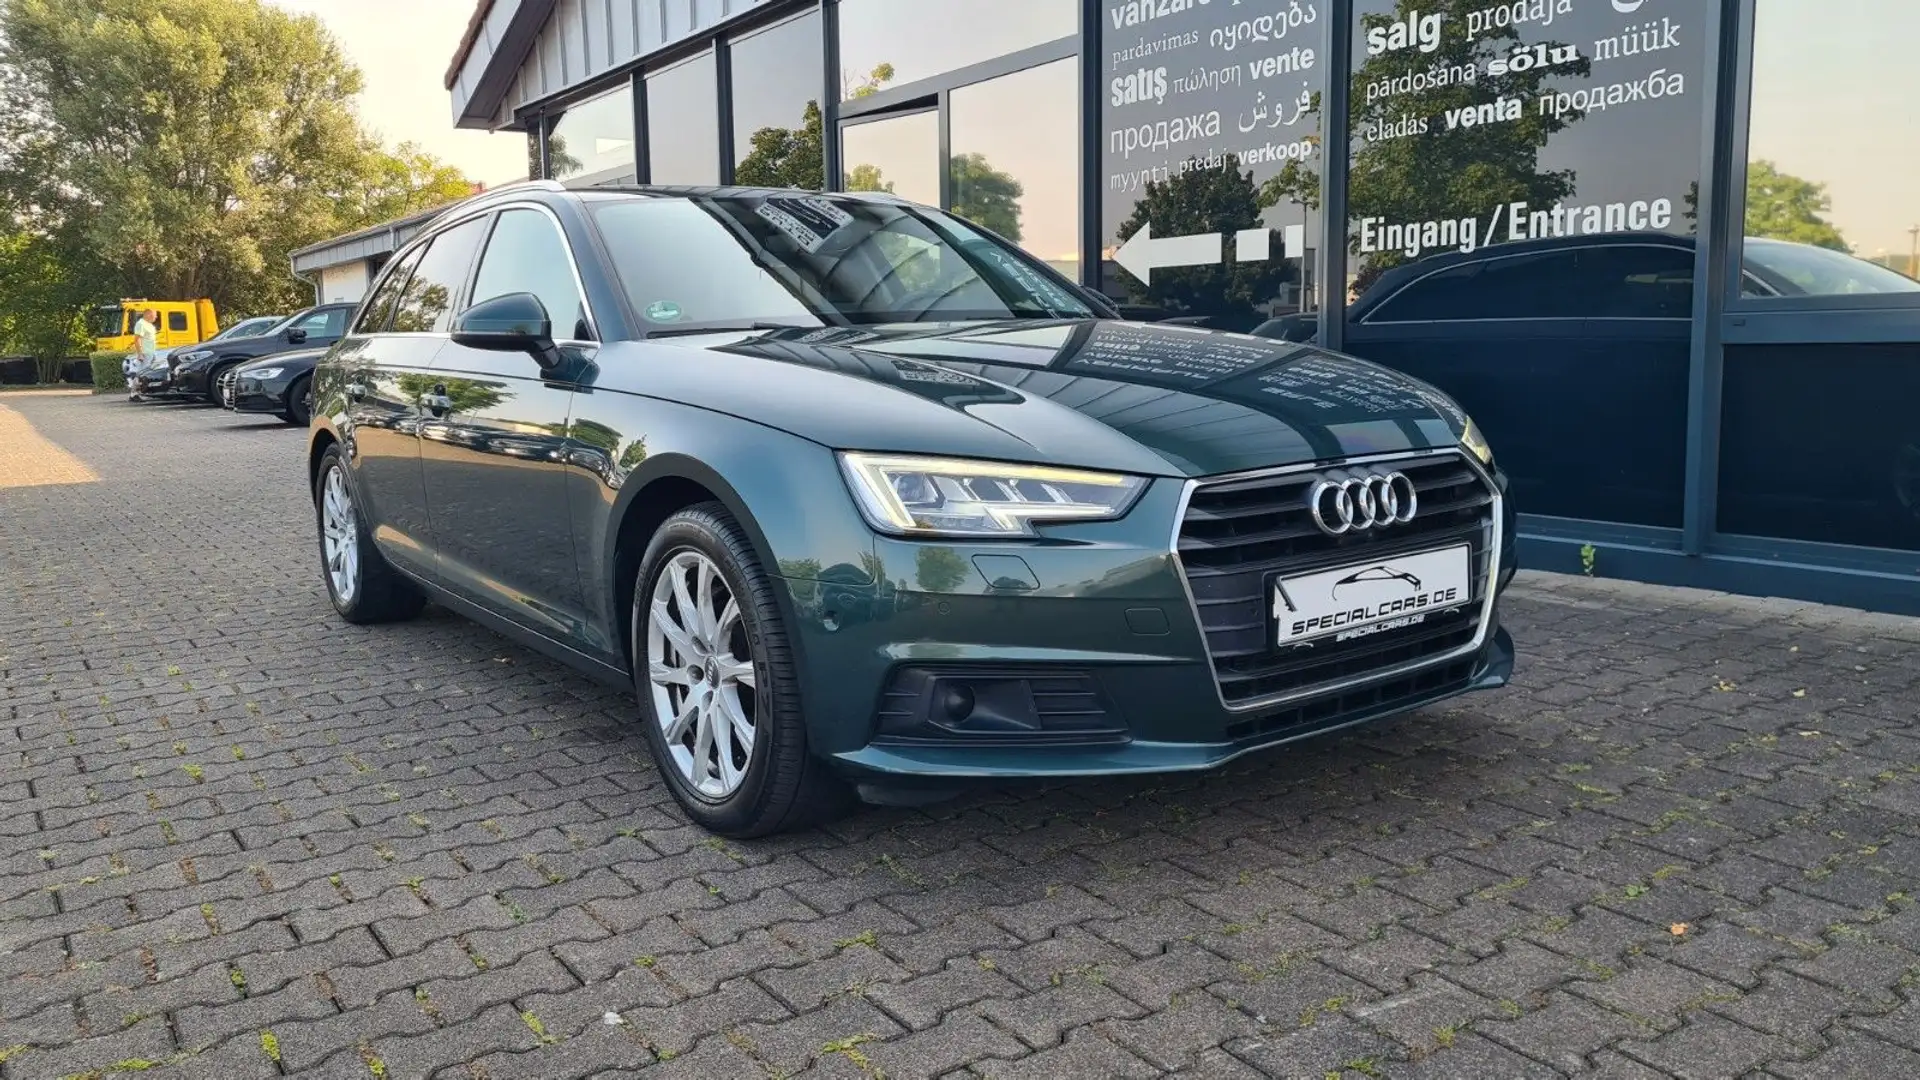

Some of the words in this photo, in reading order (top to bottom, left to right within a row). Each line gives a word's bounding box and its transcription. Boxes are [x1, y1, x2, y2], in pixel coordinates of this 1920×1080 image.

[1112, 30, 1199, 71] pardavimas
[1366, 10, 1442, 55] salg
[1594, 17, 1682, 61] müük
[1173, 65, 1241, 95] πώληση
[1249, 46, 1315, 80] vente
[1487, 43, 1581, 77] sölu
[1366, 63, 1476, 105] pārdošana
[1539, 68, 1685, 120] продажба
[1238, 81, 1311, 132] فروش
[1445, 97, 1523, 130] venta
[1111, 110, 1221, 159] продажа
[1366, 114, 1429, 143] eladás
[1179, 148, 1228, 180] predaj
[1238, 140, 1313, 166] verkoop
[1110, 160, 1169, 193] myynti
[1508, 197, 1672, 241] Entrance
[1291, 587, 1457, 636] SPECIALCARS.DE
